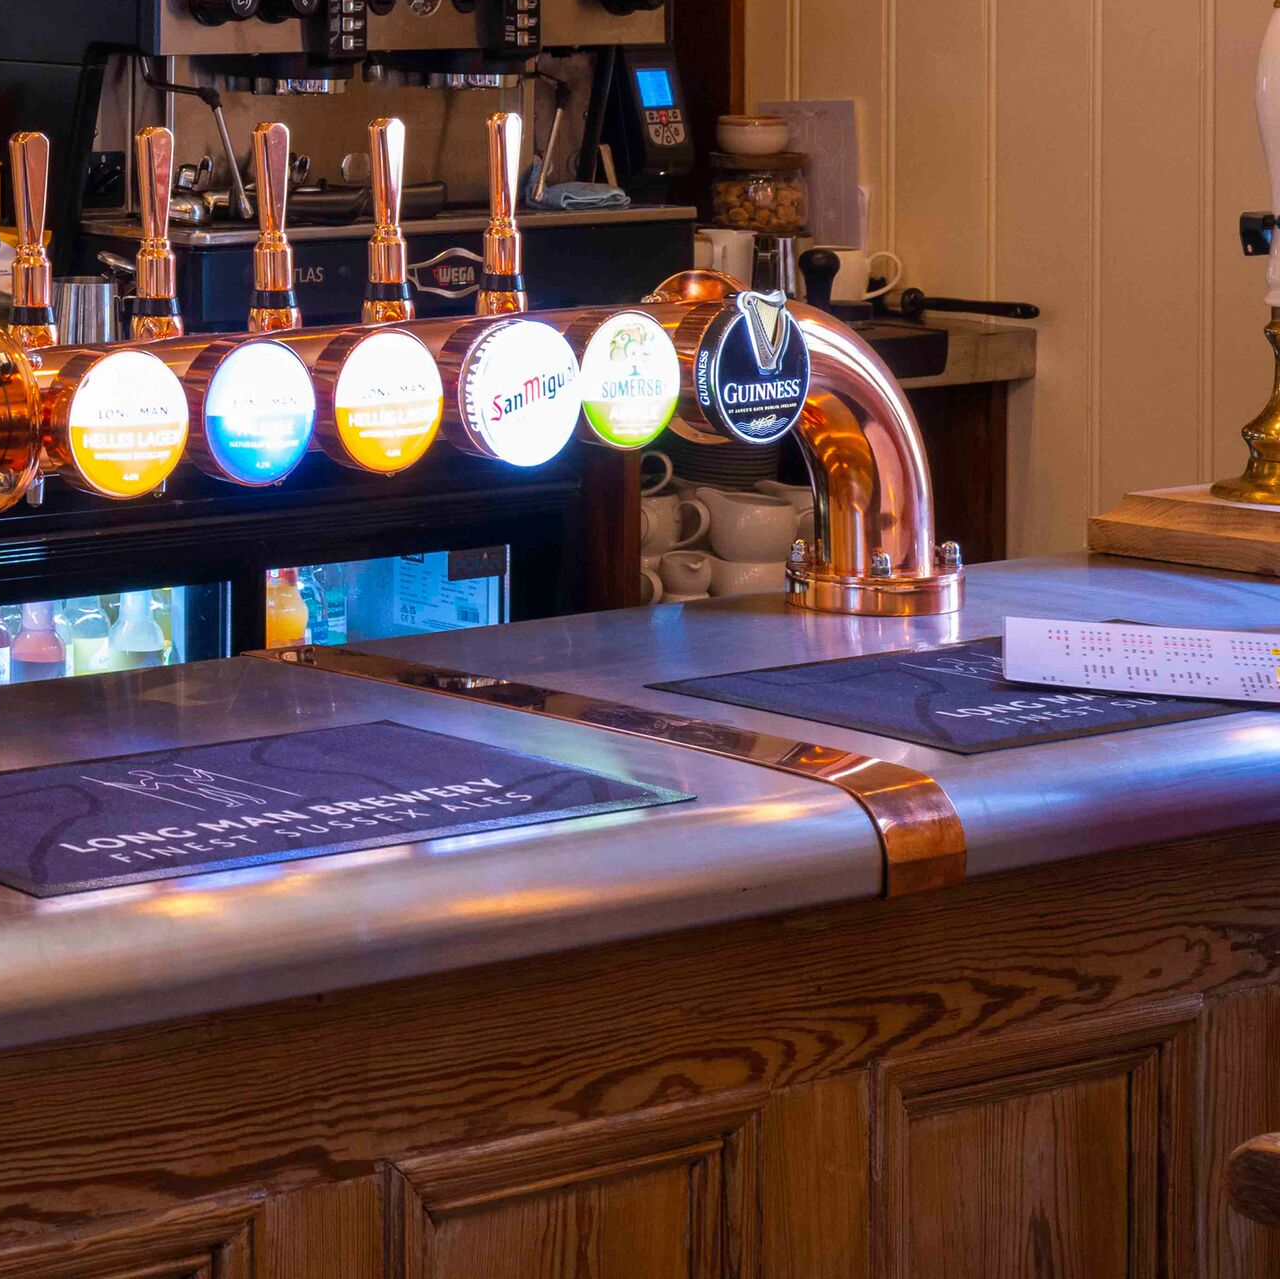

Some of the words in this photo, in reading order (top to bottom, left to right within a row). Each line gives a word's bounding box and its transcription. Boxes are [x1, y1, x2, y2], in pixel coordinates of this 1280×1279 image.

[439, 267, 475, 282] WEGA
[700, 350, 710, 406] GUINNESS
[723, 379, 800, 405] GUINNESS
[83, 430, 133, 449] HELLES
[137, 430, 181, 448] LAGER
[935, 699, 1043, 718] LONG
[59, 826, 194, 855] LONG
[197, 807, 299, 833] MAN
[308, 776, 506, 816] BREWERY
[108, 833, 259, 864] FINEST
[274, 806, 431, 839] SUSSEX
[441, 789, 533, 814] ALES
